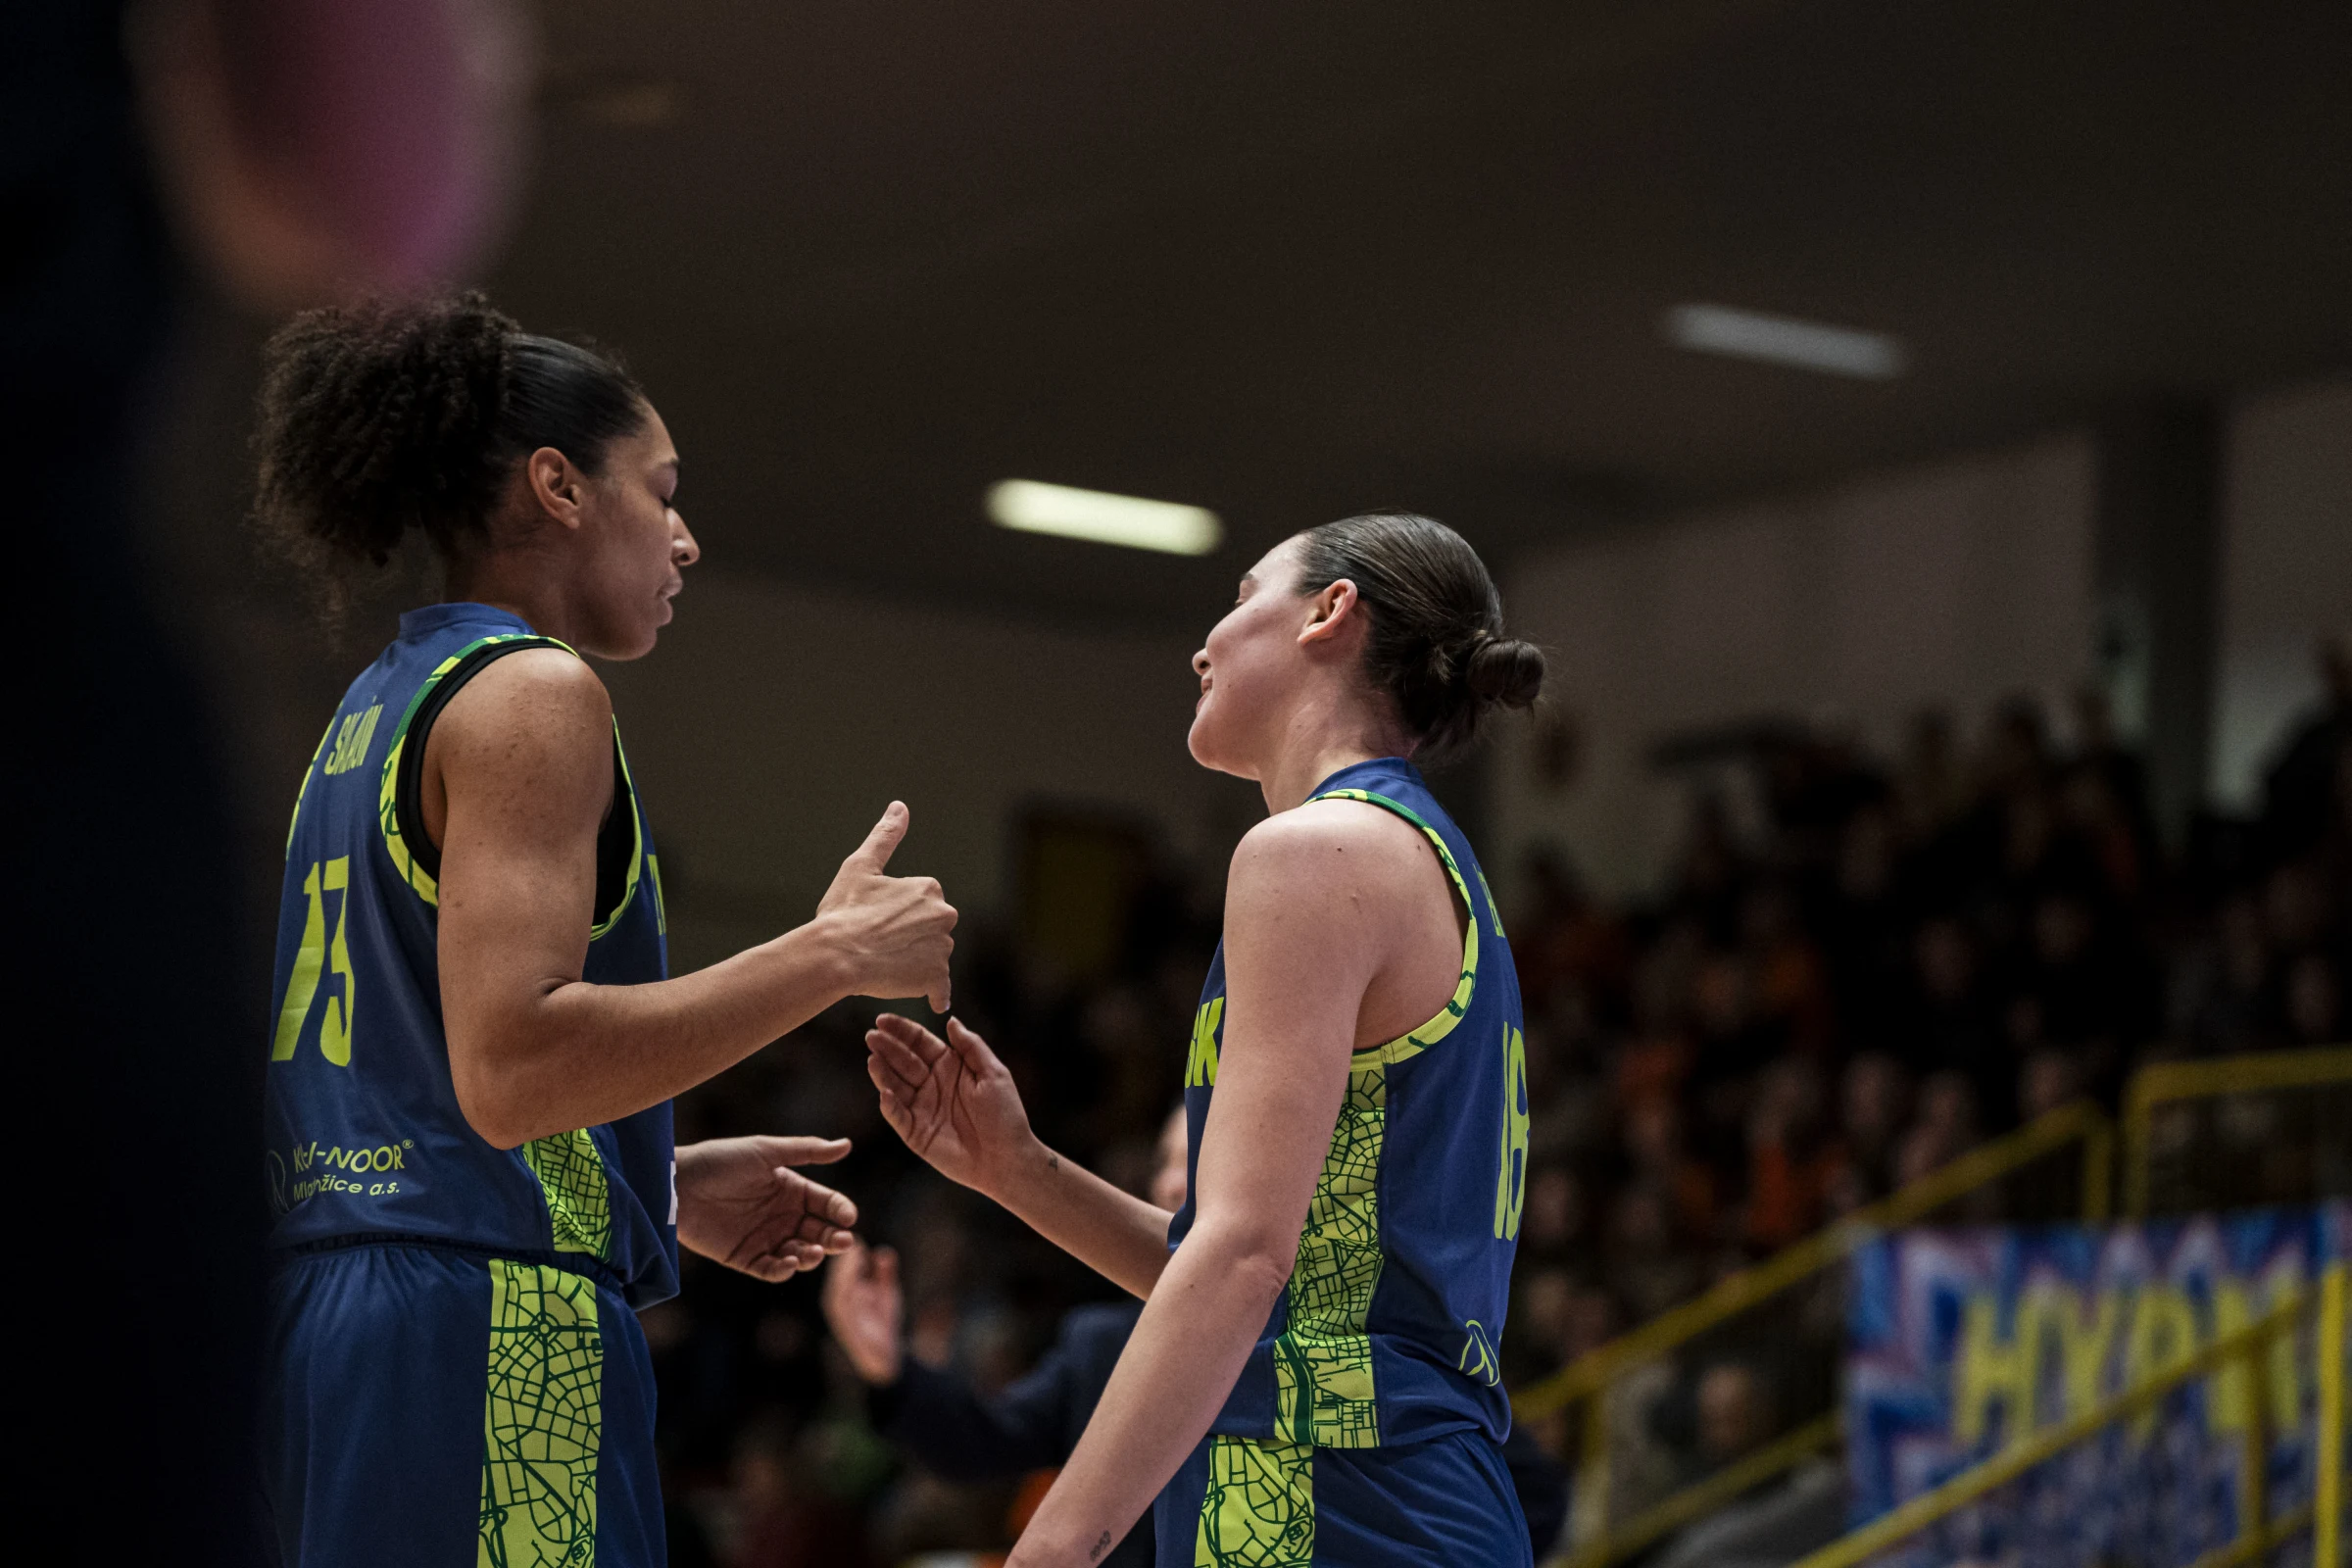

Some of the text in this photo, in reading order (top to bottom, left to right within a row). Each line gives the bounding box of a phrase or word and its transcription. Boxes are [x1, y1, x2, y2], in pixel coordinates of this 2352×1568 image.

[271, 855, 355, 1067] 13
[369, 1182, 400, 1196] a.s.
[1494, 1021, 1530, 1241] 18
